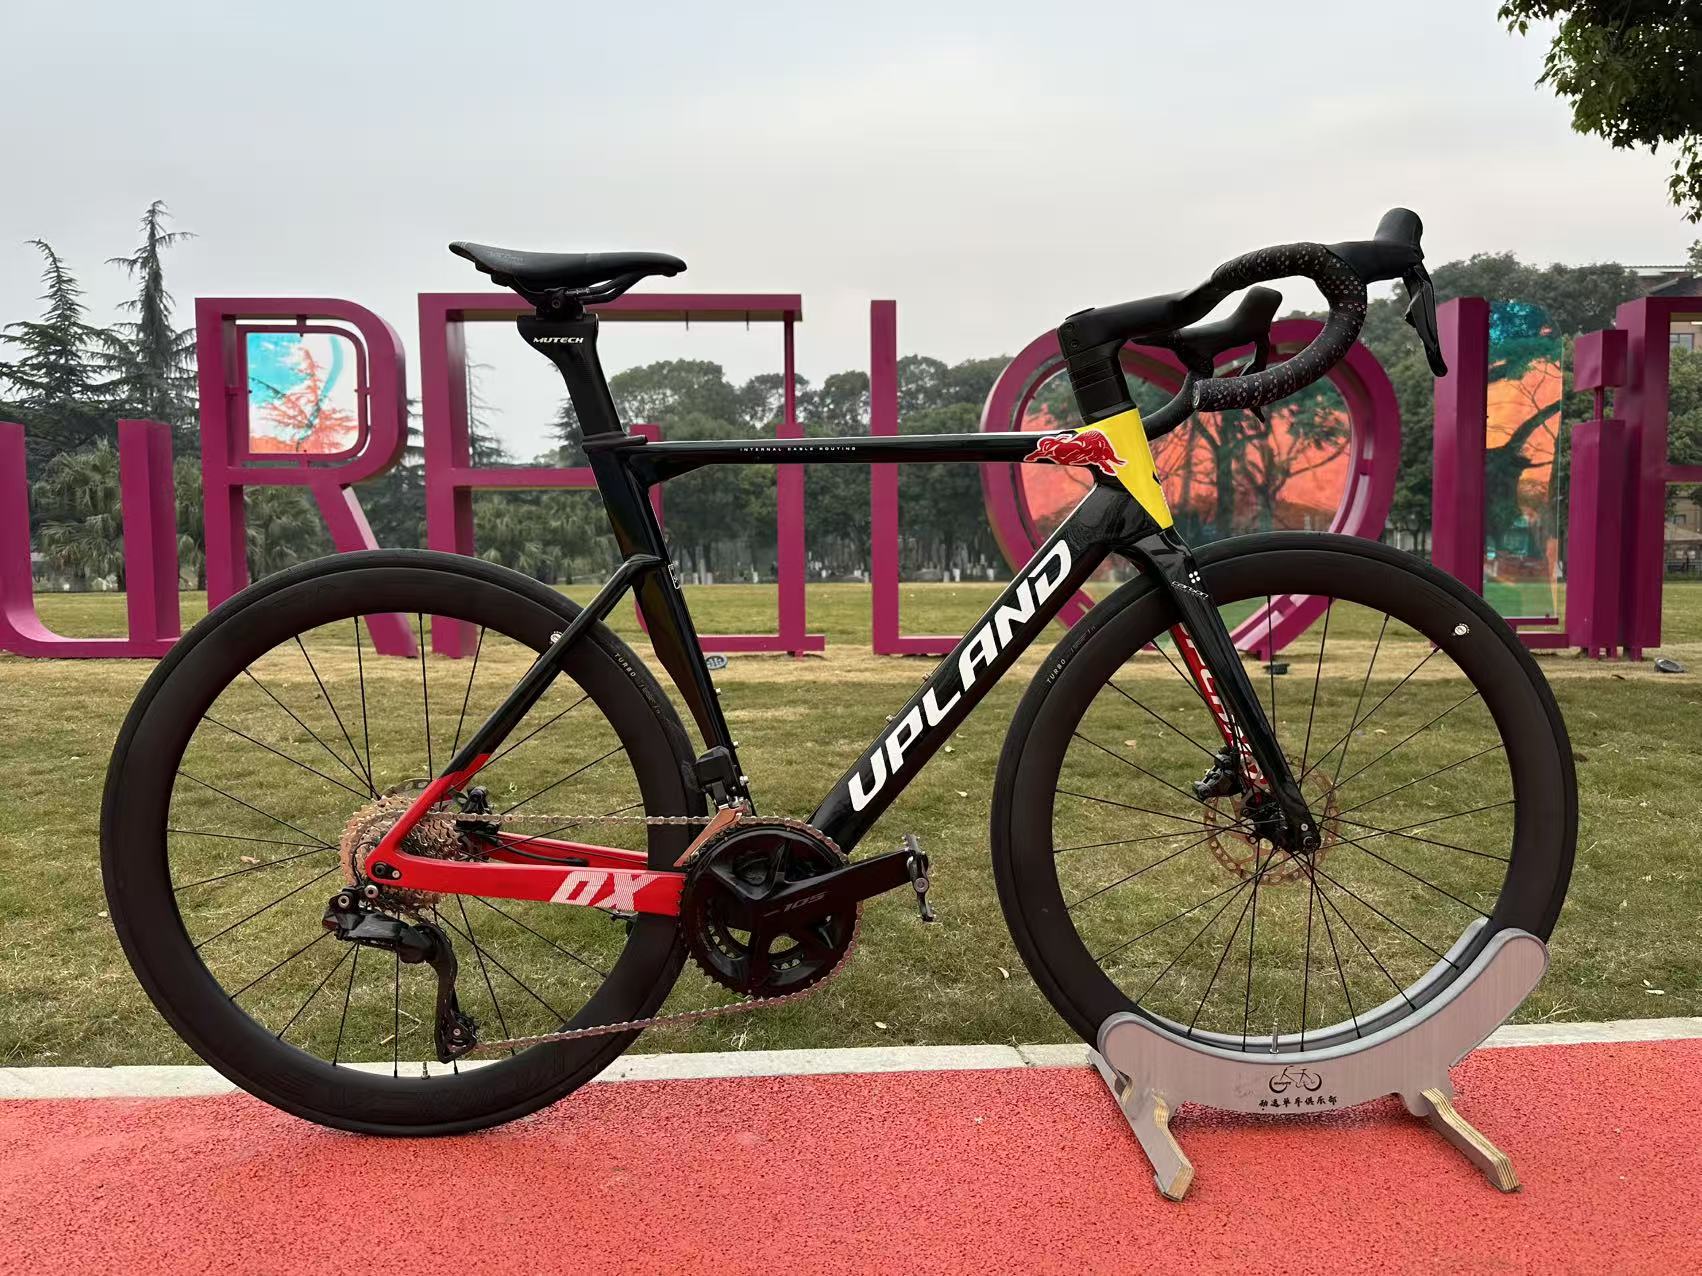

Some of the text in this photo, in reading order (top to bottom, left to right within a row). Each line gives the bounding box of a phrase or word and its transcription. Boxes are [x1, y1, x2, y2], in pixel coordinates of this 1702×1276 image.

[532, 336, 584, 344] MUTECH
[614, 652, 637, 677] TURBO
[847, 539, 1072, 812] UPLAND
[1046, 658, 1066, 684] TURBO
[783, 891, 830, 912] 105
